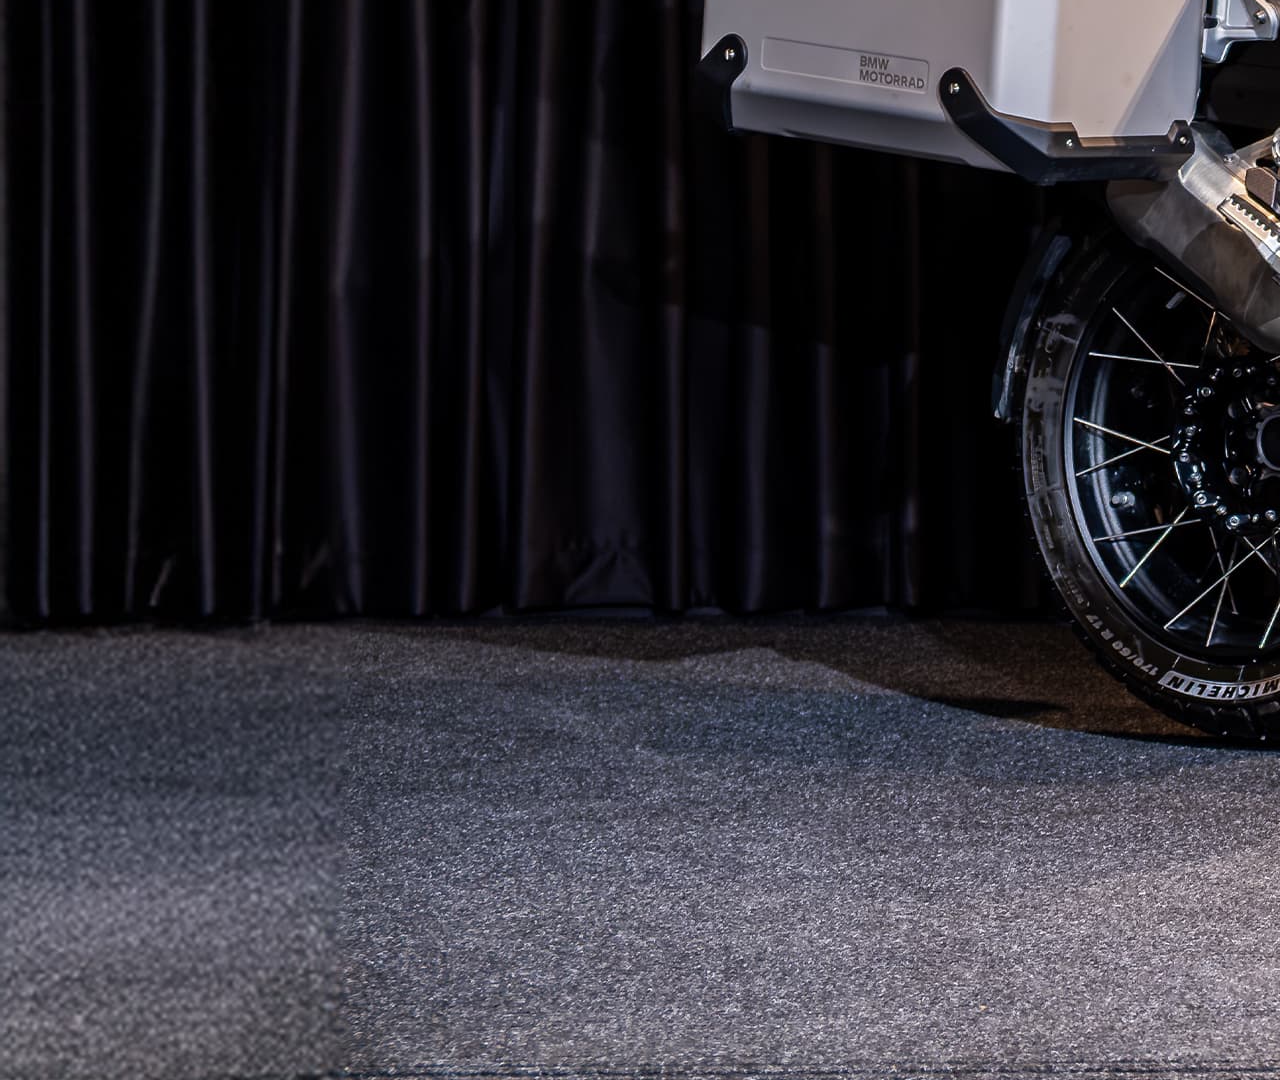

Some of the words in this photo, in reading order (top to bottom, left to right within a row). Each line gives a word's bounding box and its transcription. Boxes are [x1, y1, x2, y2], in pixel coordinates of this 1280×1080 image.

[860, 55, 890, 71] BMW
[859, 69, 925, 89] MOTORRAD
[1167, 675, 1280, 699] MICHELIN
